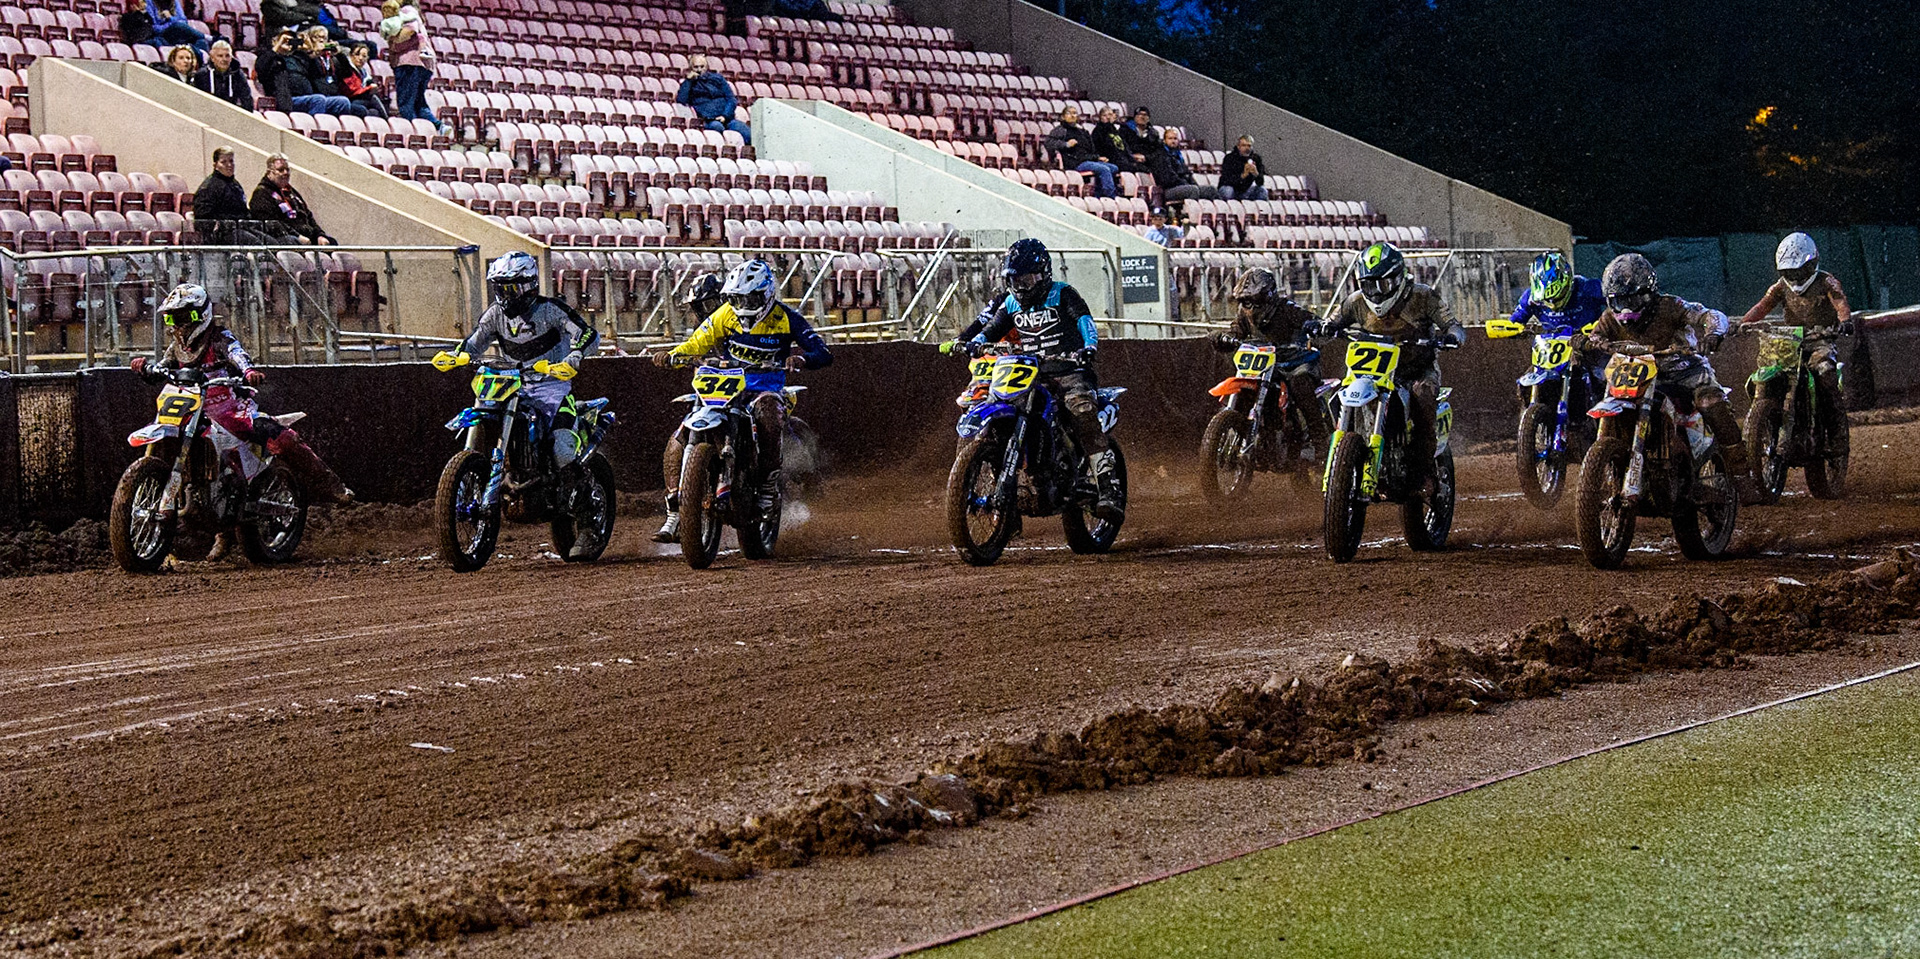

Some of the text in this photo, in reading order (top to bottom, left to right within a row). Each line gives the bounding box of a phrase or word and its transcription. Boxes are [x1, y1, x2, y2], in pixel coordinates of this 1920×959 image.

[1121, 259, 1140, 267] LOCK
[1122, 275, 1149, 284] LOCK G
[1238, 354, 1270, 370] 90
[1351, 348, 1393, 374] 21
[697, 377, 740, 395] 34
[993, 366, 1033, 388] 22
[1611, 363, 1649, 388] 69
[479, 377, 516, 398] 17
[159, 396, 197, 417] 8
